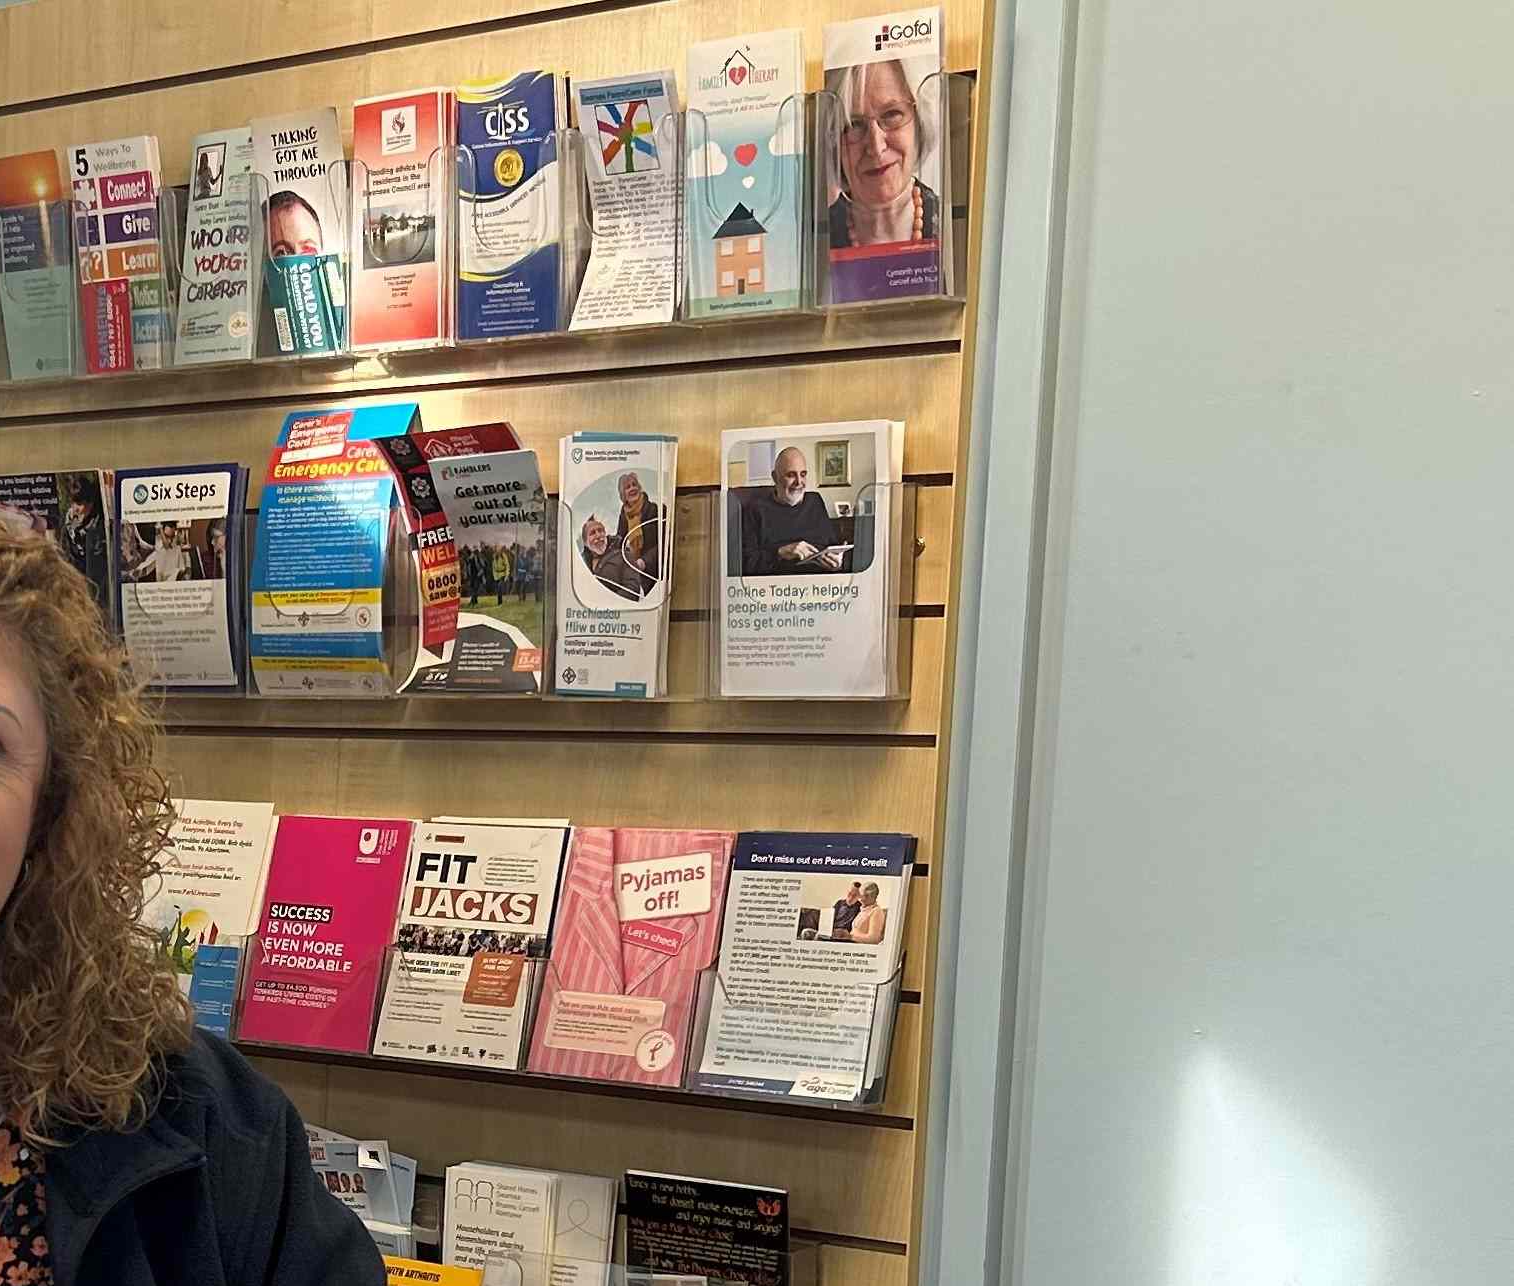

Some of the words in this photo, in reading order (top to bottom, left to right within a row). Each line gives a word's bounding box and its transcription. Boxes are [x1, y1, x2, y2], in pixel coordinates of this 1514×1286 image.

[890, 18, 932, 40] Gofal
[271, 127, 317, 147] TALKING
[76, 149, 88, 176] 5
[276, 150, 298, 164] GOT
[302, 147, 318, 161] ME
[274, 163, 326, 184] THROUGH
[107, 176, 146, 201] Connect
[122, 215, 151, 234] Give
[122, 251, 158, 271] Learn
[274, 462, 354, 478] Emergency
[151, 484, 172, 501] Six
[176, 482, 216, 501] Steps
[455, 485, 481, 497] Get
[482, 480, 520, 494] more
[474, 499, 500, 510] out
[503, 495, 519, 508] of
[459, 513, 495, 528] your
[496, 509, 538, 524] walks
[418, 526, 453, 548] FREE
[428, 573, 457, 591] 0800
[727, 585, 766, 598] Online
[812, 584, 859, 598] helping
[727, 601, 767, 615] people
[771, 600, 796, 612] with
[800, 601, 851, 613] sensory
[598, 622, 641, 635] COVID-19
[727, 617, 750, 629] loss
[754, 619, 773, 630] get
[777, 616, 815, 628] online
[416, 853, 478, 884] FIT
[751, 854, 774, 863] Don't
[824, 856, 859, 866] Pension
[861, 858, 888, 867] Credit
[620, 865, 705, 892] Pyjamas
[414, 889, 534, 924] JACKS
[644, 890, 680, 911] off!
[271, 905, 331, 921] SUCCESS
[268, 921, 279, 933] IS
[282, 922, 317, 936] NOW
[628, 925, 648, 940] Let's
[650, 933, 678, 949] check
[265, 938, 299, 952] EVEN
[302, 941, 344, 956] MORE
[261, 953, 352, 972] AFFORDABLE
